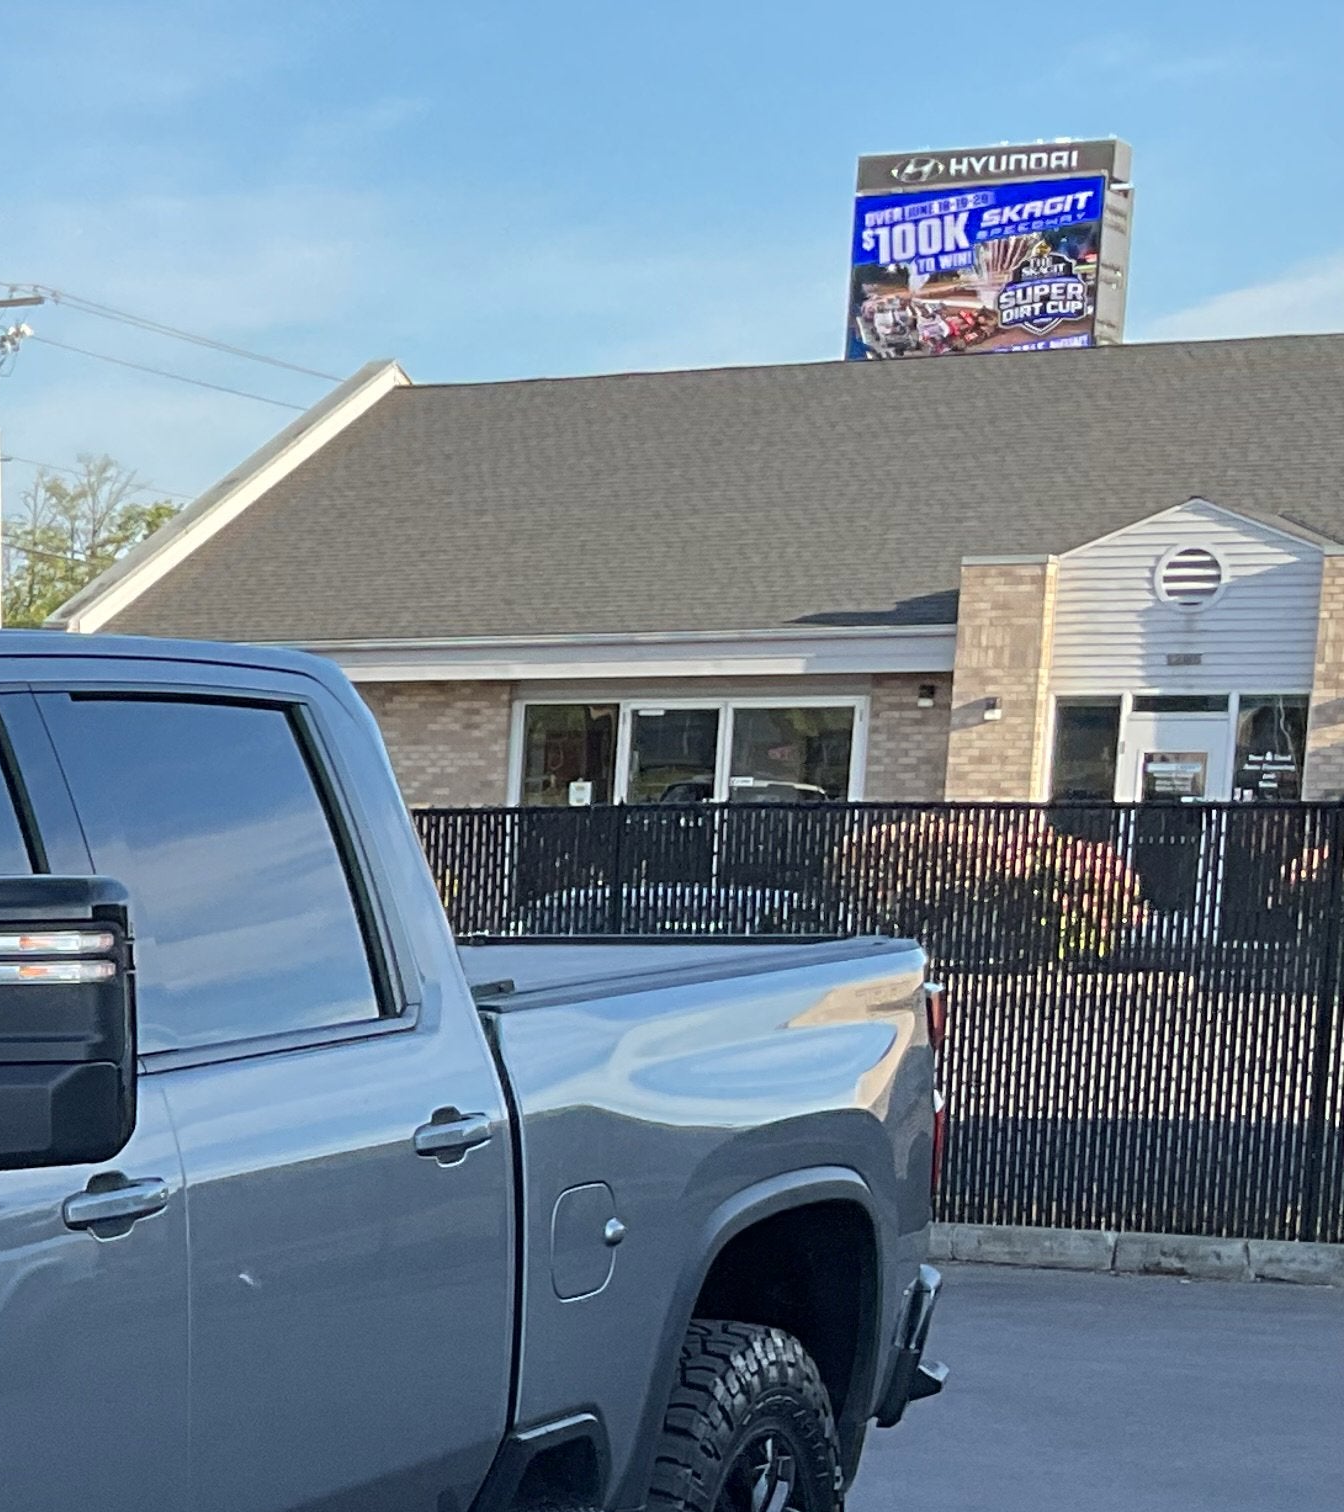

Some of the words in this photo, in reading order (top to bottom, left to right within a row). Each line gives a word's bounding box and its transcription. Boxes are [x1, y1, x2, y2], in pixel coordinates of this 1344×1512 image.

[949, 151, 1079, 177] HYUNDAI
[980, 190, 1094, 228] SKAGIT
[862, 211, 970, 265] $100K
[917, 257, 936, 273] TO
[999, 282, 1084, 310] SUPER
[1002, 302, 1043, 323] DIRT
[1045, 300, 1083, 315] CUP
